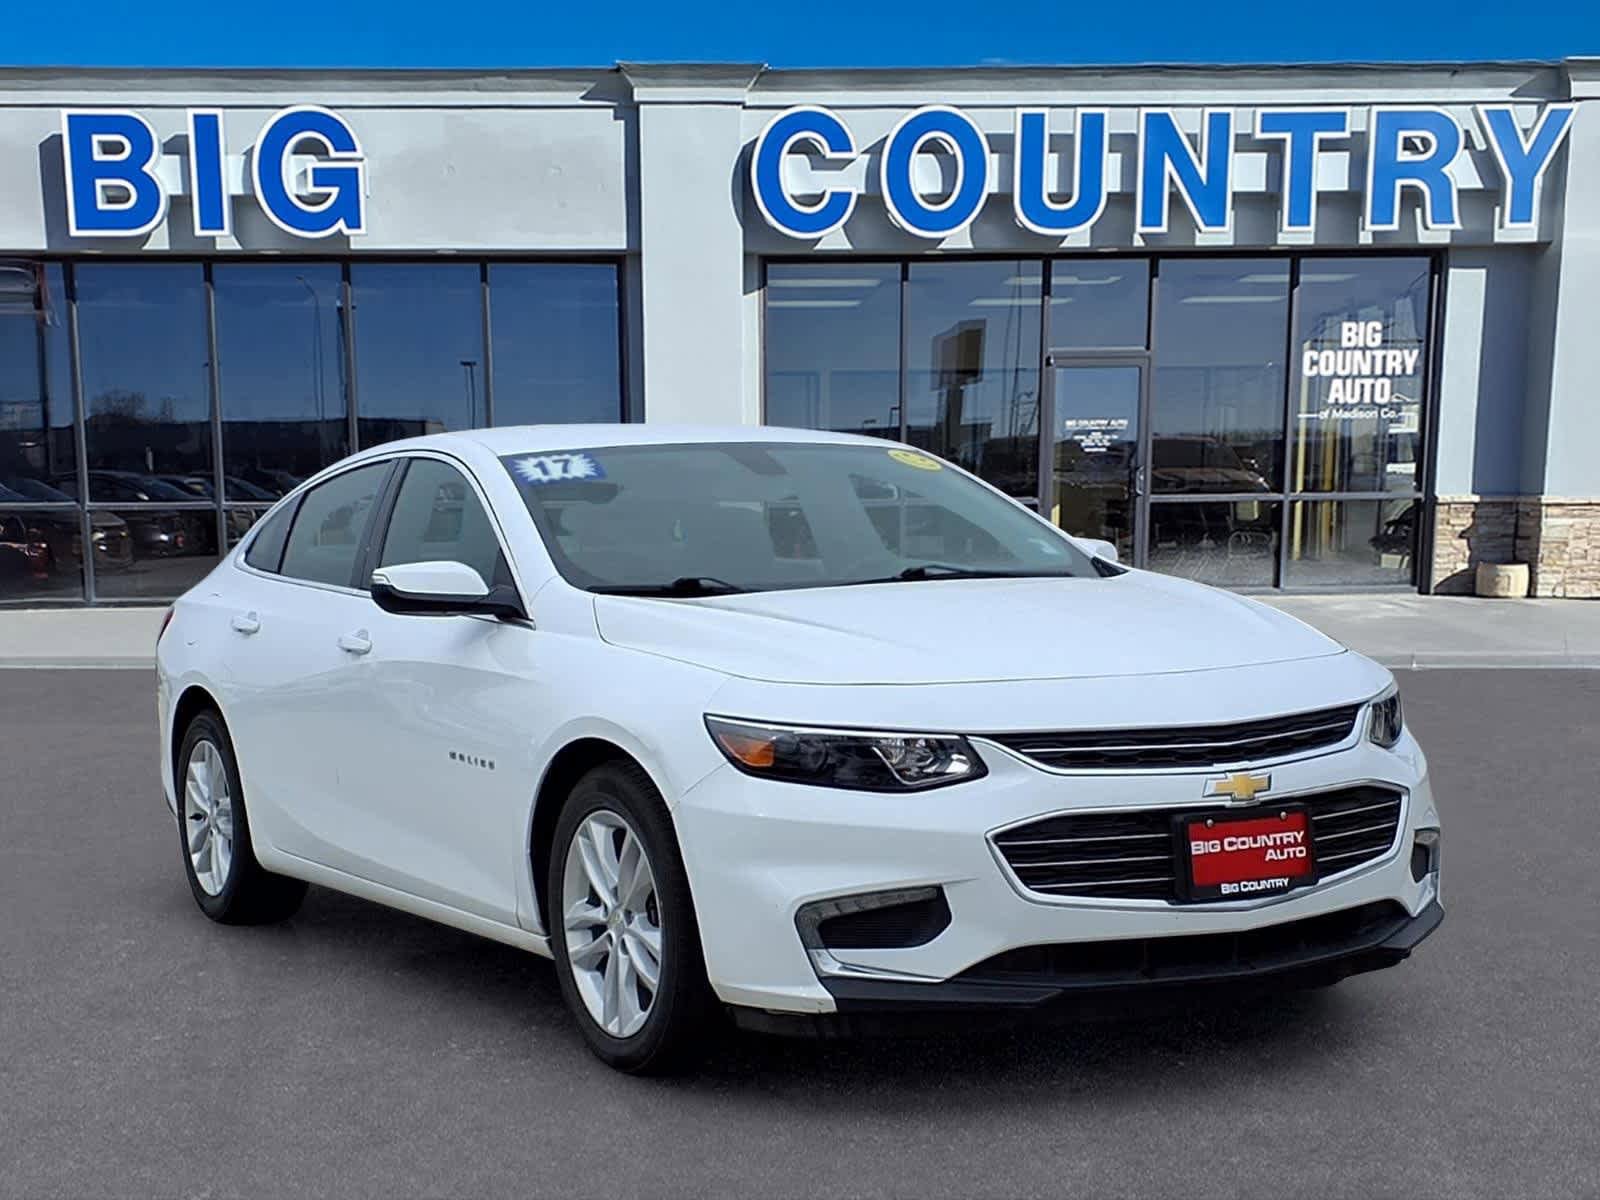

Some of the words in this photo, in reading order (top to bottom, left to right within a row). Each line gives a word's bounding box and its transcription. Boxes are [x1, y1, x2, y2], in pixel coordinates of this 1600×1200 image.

[60, 104, 368, 239] BIG
[751, 102, 1576, 240] COUNTRY
[1341, 320, 1383, 348] BIG
[1302, 349, 1419, 377] COUNTRY
[1328, 378, 1392, 404] AUTO
[1319, 407, 1330, 420] of
[1332, 407, 1378, 419] Madison
[1380, 407, 1398, 419] Co.
[533, 458, 571, 477] 17
[1190, 840, 1221, 855] BIG
[1223, 831, 1305, 852] COUNTRY
[1265, 846, 1307, 861] AUTO
[1220, 882, 1240, 895] BIG
[1240, 877, 1290, 892] COUNTRY
